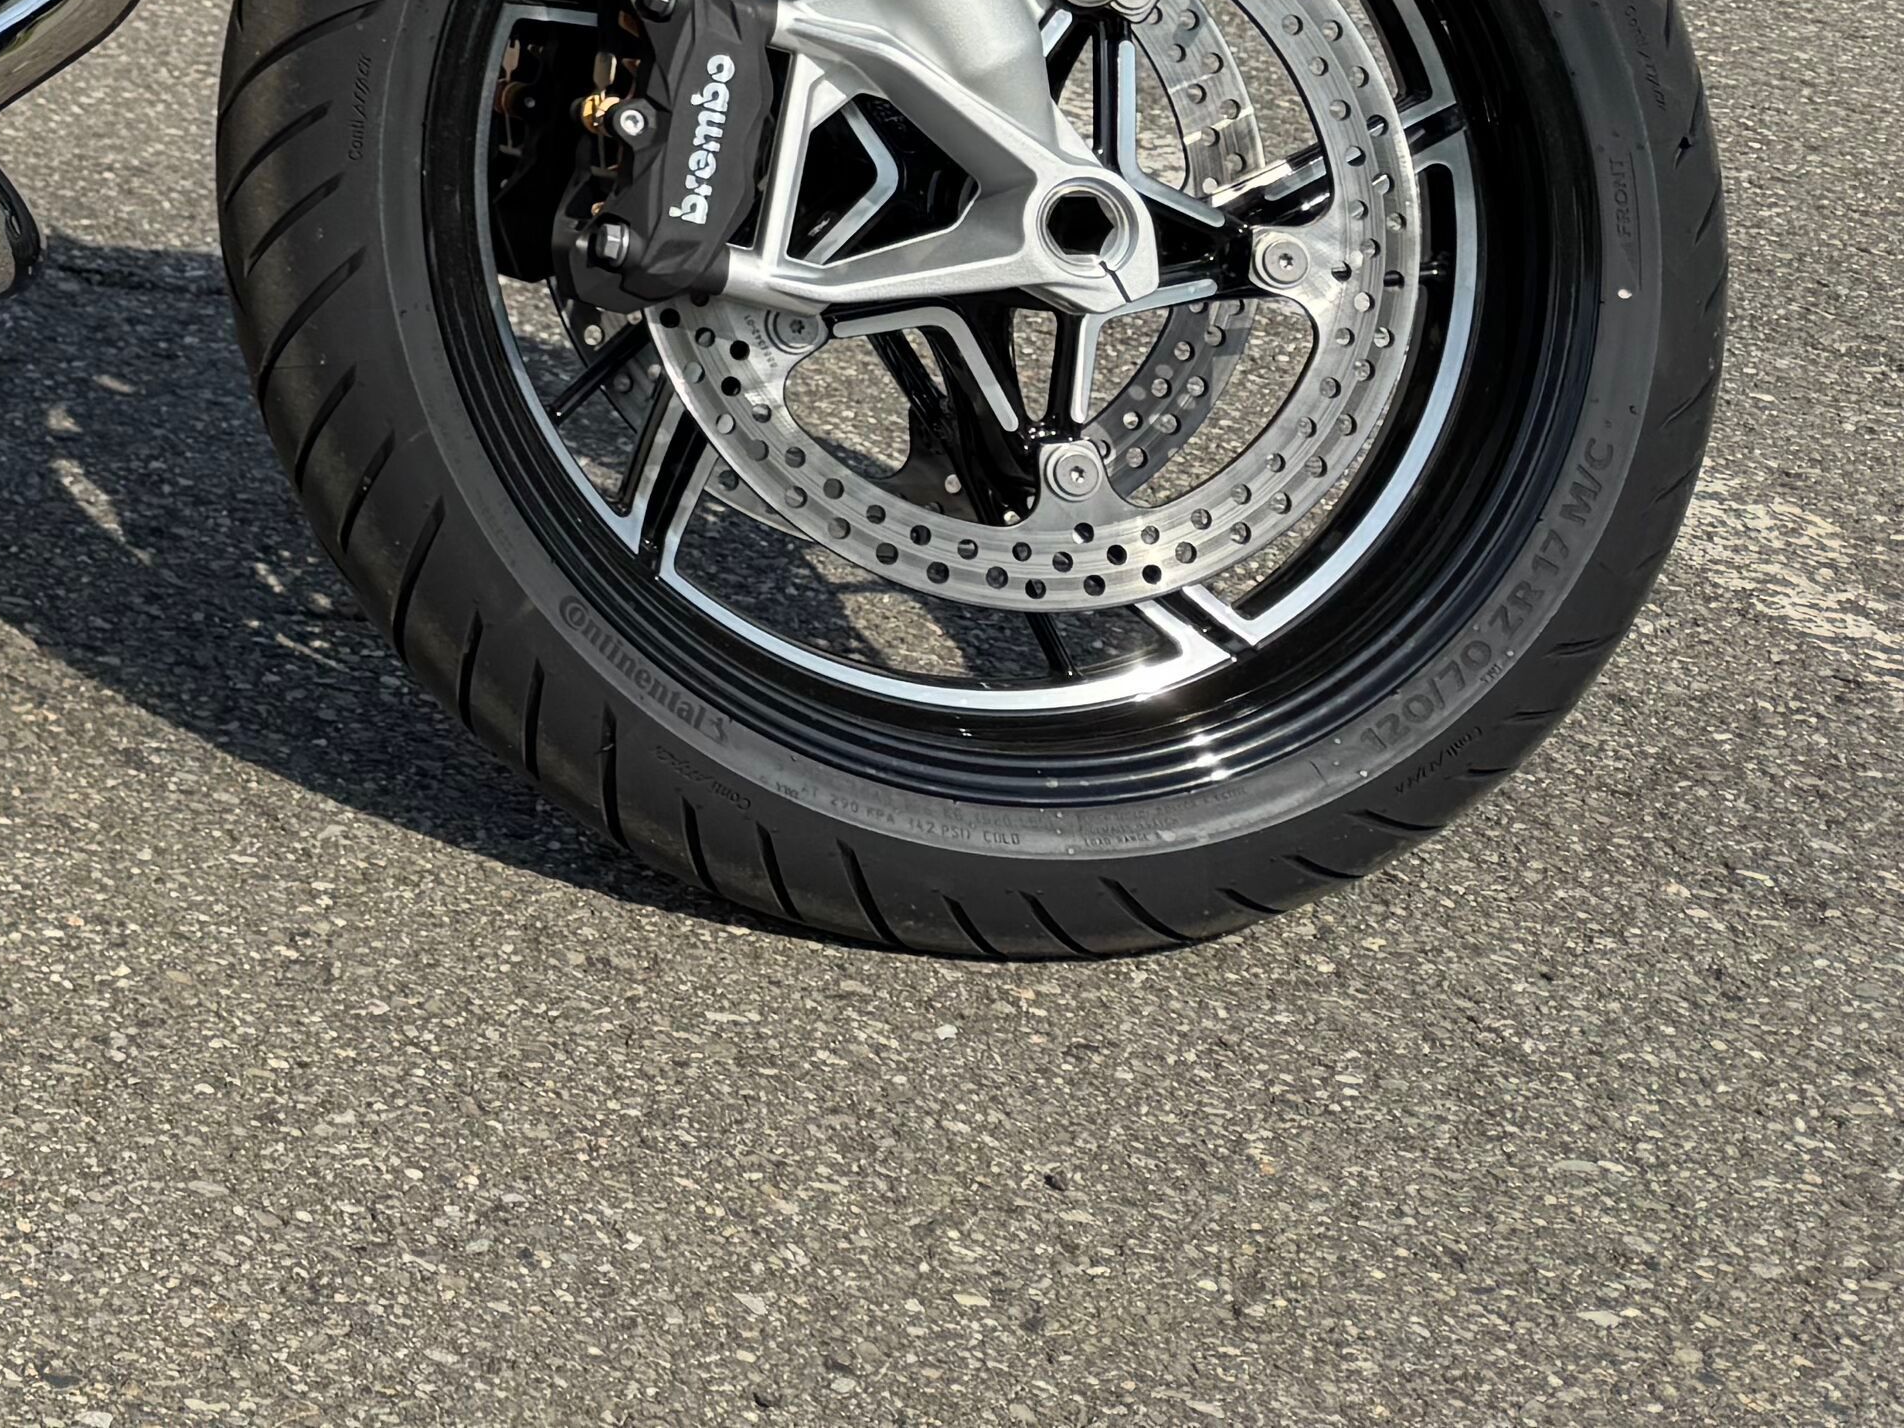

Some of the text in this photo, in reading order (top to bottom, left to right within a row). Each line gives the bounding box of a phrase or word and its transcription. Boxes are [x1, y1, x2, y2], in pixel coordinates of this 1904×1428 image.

[669, 54, 736, 225] brembo
[1609, 157, 1633, 238] FRONT
[559, 594, 708, 731] Continental
[1360, 437, 1615, 753] 120/70 ZR 17 M/C
